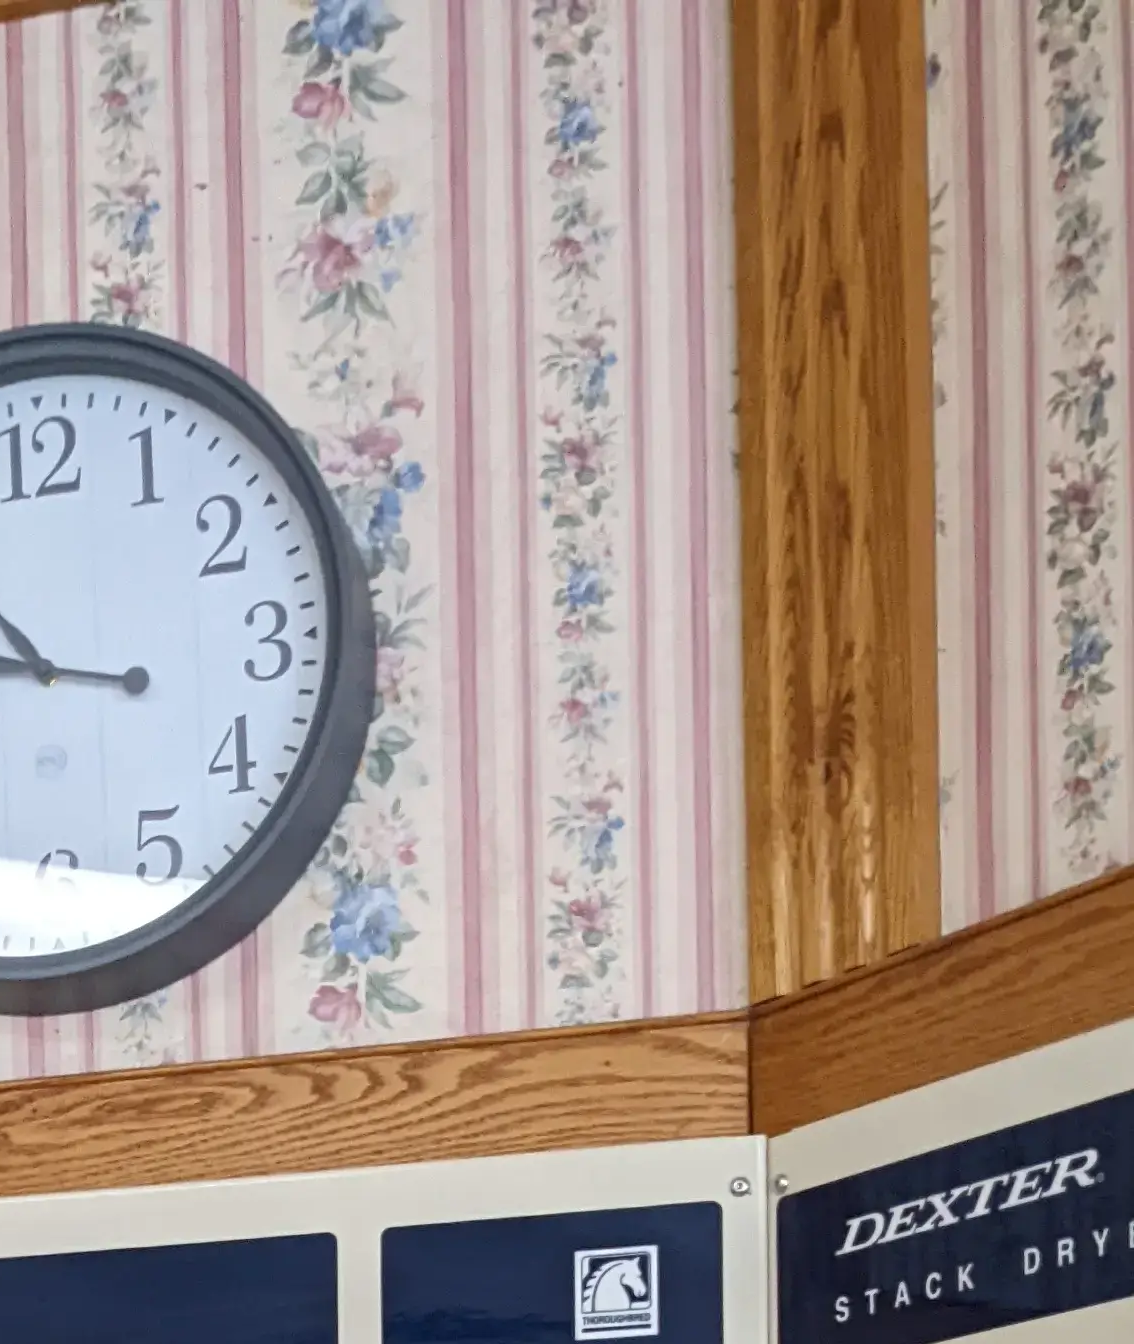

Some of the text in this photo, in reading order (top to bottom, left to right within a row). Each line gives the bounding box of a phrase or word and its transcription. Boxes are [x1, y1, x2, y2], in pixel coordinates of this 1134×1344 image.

[128, 425, 165, 507] 1
[195, 493, 248, 577] 2
[243, 600, 293, 681] 3
[208, 714, 257, 795] 4
[135, 804, 184, 885] 5
[834, 1147, 1100, 1257] DEXTER
[582, 1312, 652, 1327] THOROUGHBRED
[834, 1262, 975, 1324] STACK
